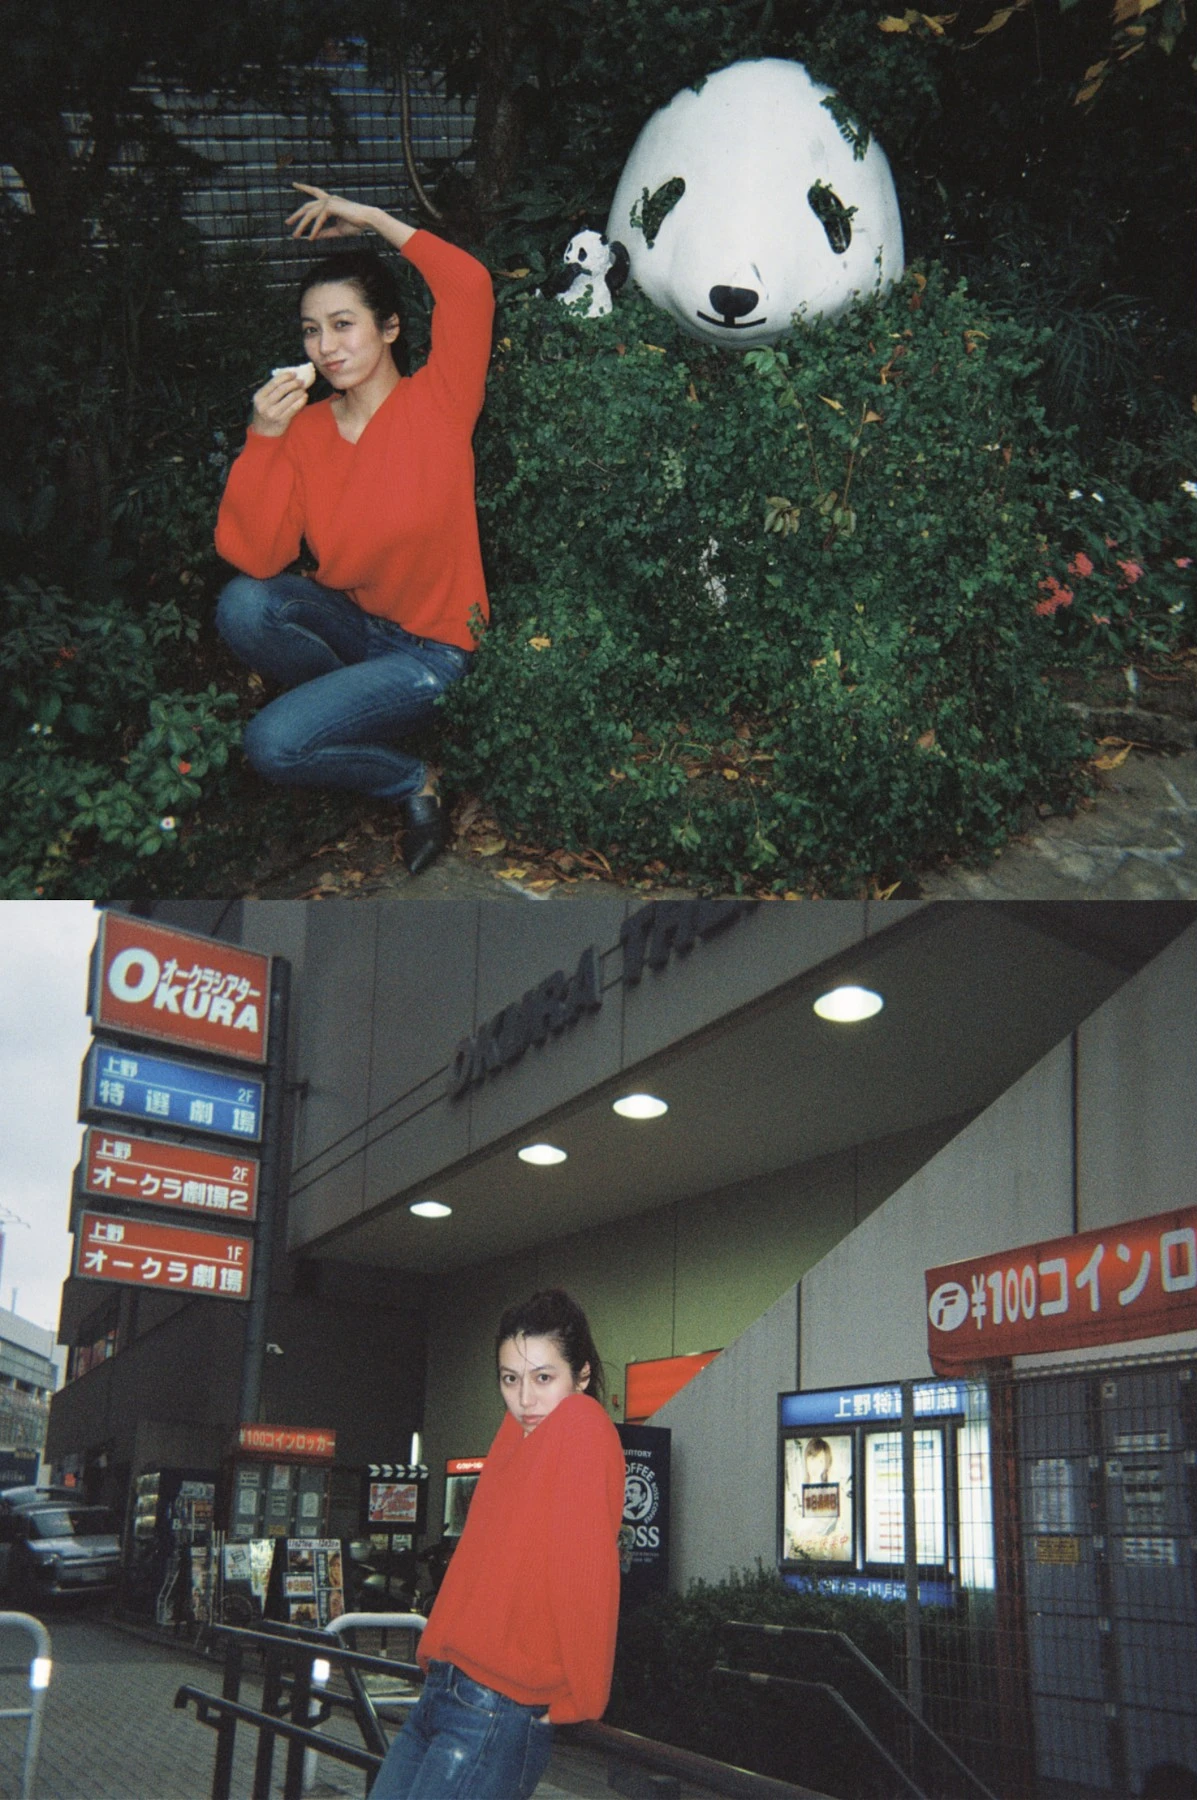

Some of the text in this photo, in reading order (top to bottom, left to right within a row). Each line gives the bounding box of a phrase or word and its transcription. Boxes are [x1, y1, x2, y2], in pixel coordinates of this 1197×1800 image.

[108, 947, 259, 1033] OKURA
[161, 958, 261, 1003] オークラシアター
[103, 1056, 138, 1078] 上野
[238, 1087, 255, 1103] 2F
[99, 1080, 256, 1134] 特選劇場
[96, 1139, 132, 1160] 上野
[232, 1165, 249, 1181] 2F
[92, 1166, 249, 1212] オークラ劇場2
[88, 1222, 125, 1242] 上野
[227, 1245, 243, 1261] 1F
[84, 1249, 243, 1293] オークラ劇場
[623, 1449, 652, 1458] UNTORY
[625, 1462, 655, 1483] OFFEE
[626, 1525, 660, 1548] SS
